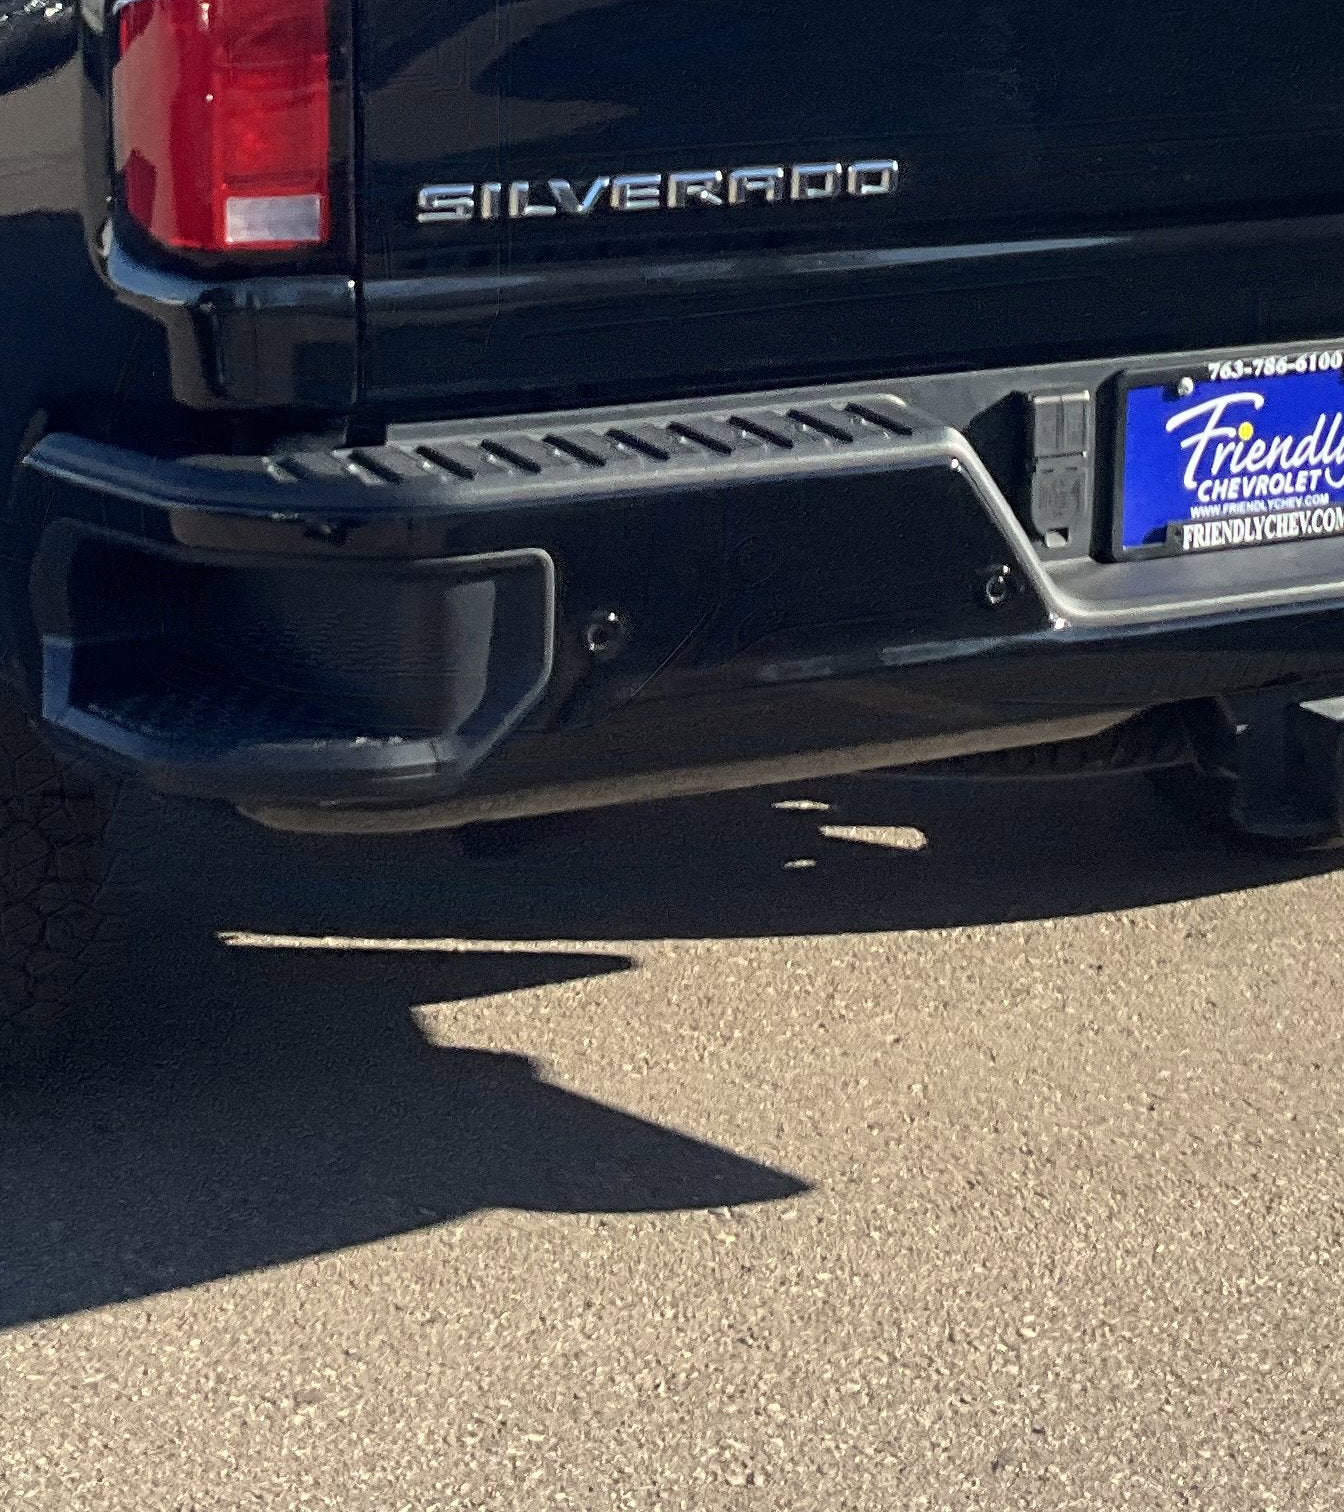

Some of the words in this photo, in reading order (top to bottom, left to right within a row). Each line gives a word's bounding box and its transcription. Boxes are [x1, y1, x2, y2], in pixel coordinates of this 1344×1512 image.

[416, 159, 900, 222] SILVERADO
[1208, 350, 1343, 381] 763-786-6100
[1197, 469, 1322, 502] CHEVROLET
[1190, 493, 1330, 519] WWW.FRIENDLYCHEV.COM
